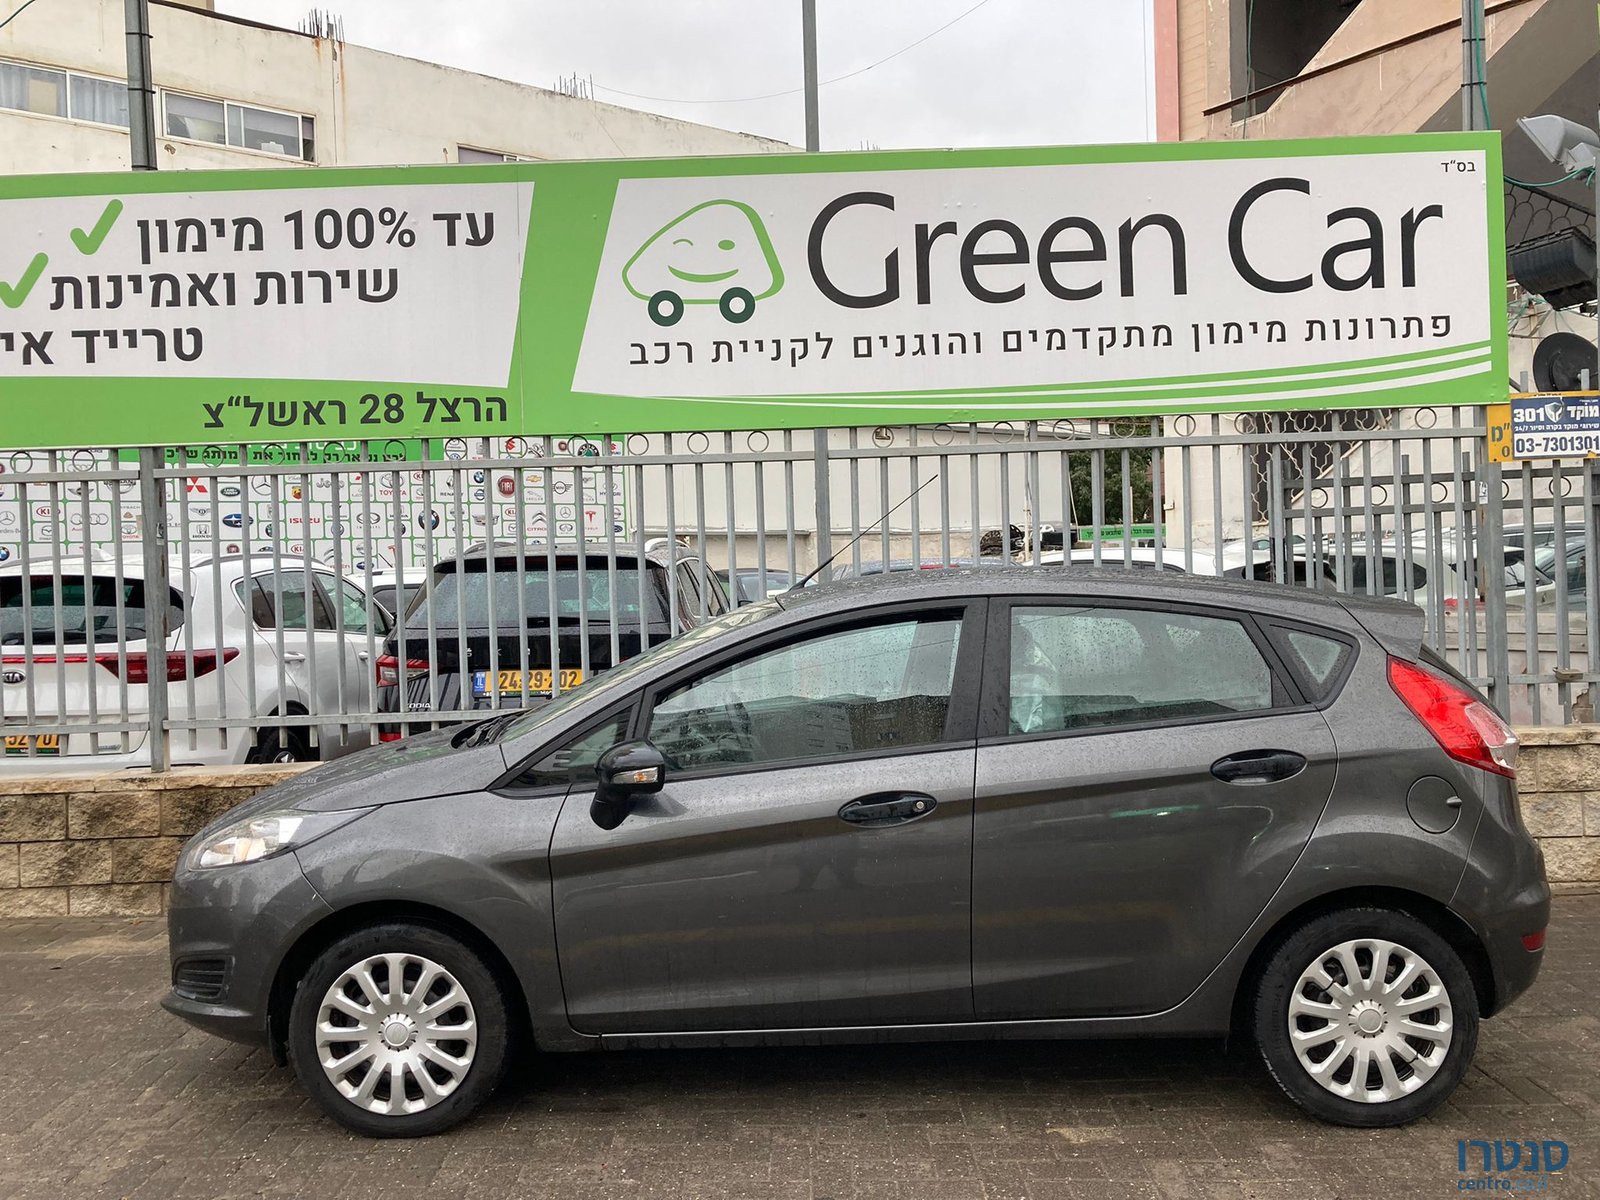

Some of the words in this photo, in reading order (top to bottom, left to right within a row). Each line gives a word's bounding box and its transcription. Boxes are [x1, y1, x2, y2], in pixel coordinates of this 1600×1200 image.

[136, 216, 265, 265] מימון
[284, 207, 416, 250] 100%
[432, 210, 495, 247] עד
[807, 191, 1188, 309] Green
[1228, 177, 1443, 294] Car
[50, 271, 236, 311] ואמינות
[254, 267, 399, 306] שירות
[71, 327, 203, 364] טרייד
[853, 330, 982, 359] והוגנים
[1003, 323, 1173, 356] מתקדמים
[1190, 318, 1287, 353] מימון
[1304, 314, 1452, 342] פתרונות
[629, 340, 694, 366] רכב
[711, 331, 834, 368] לקניית
[359, 393, 404, 425] 28
[416, 391, 508, 424] הרצל
[1513, 407, 1545, 423] 301
[1515, 435, 1600, 453] 03-7301301
